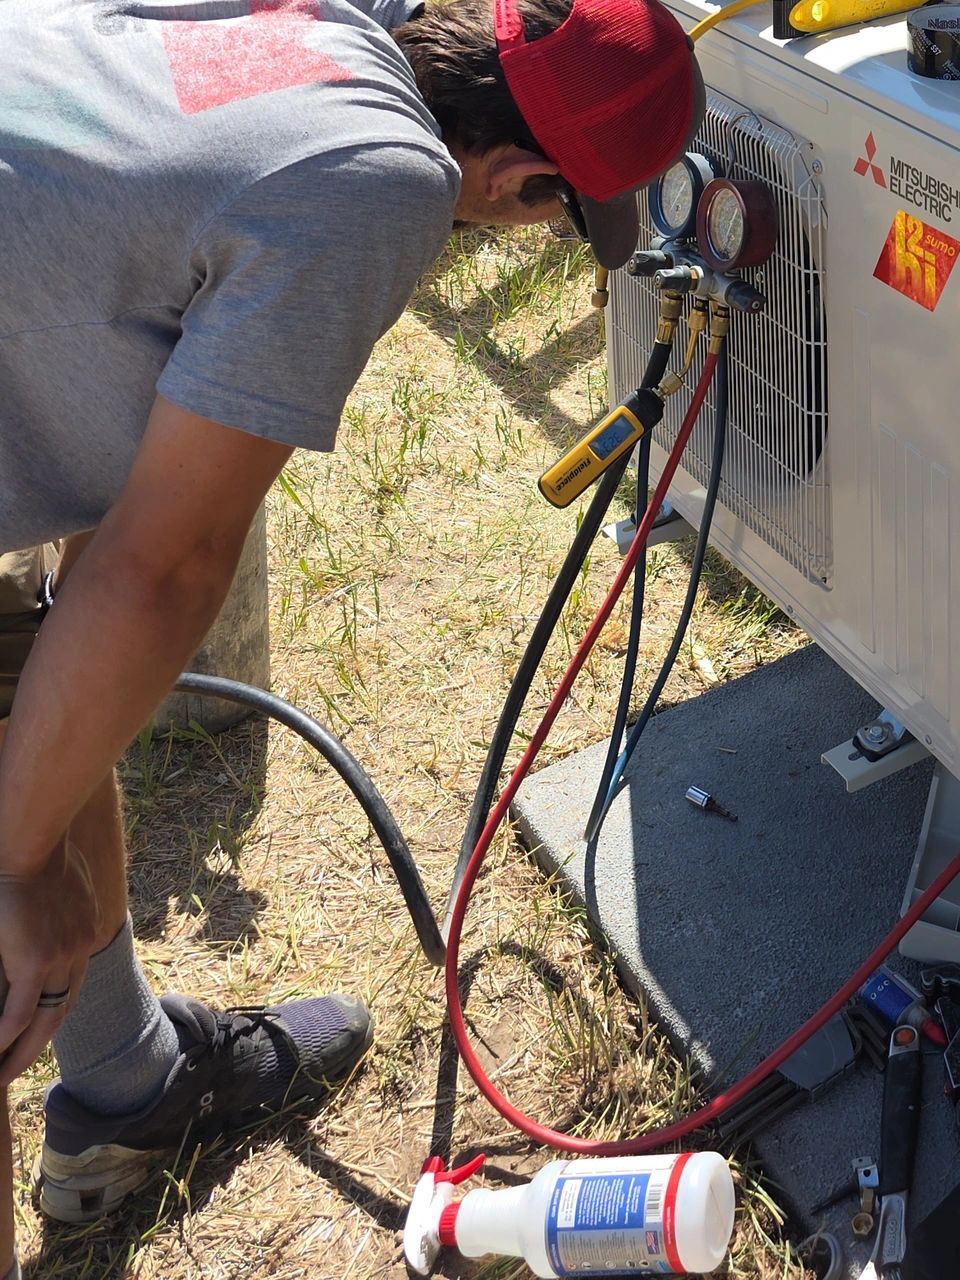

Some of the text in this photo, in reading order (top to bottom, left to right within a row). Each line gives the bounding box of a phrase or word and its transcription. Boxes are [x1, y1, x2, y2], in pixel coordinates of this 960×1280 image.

[889, 175, 952, 223] ELECTRIC
[925, 232, 956, 258] sumo
[556, 456, 592, 492] Fieldpiece
